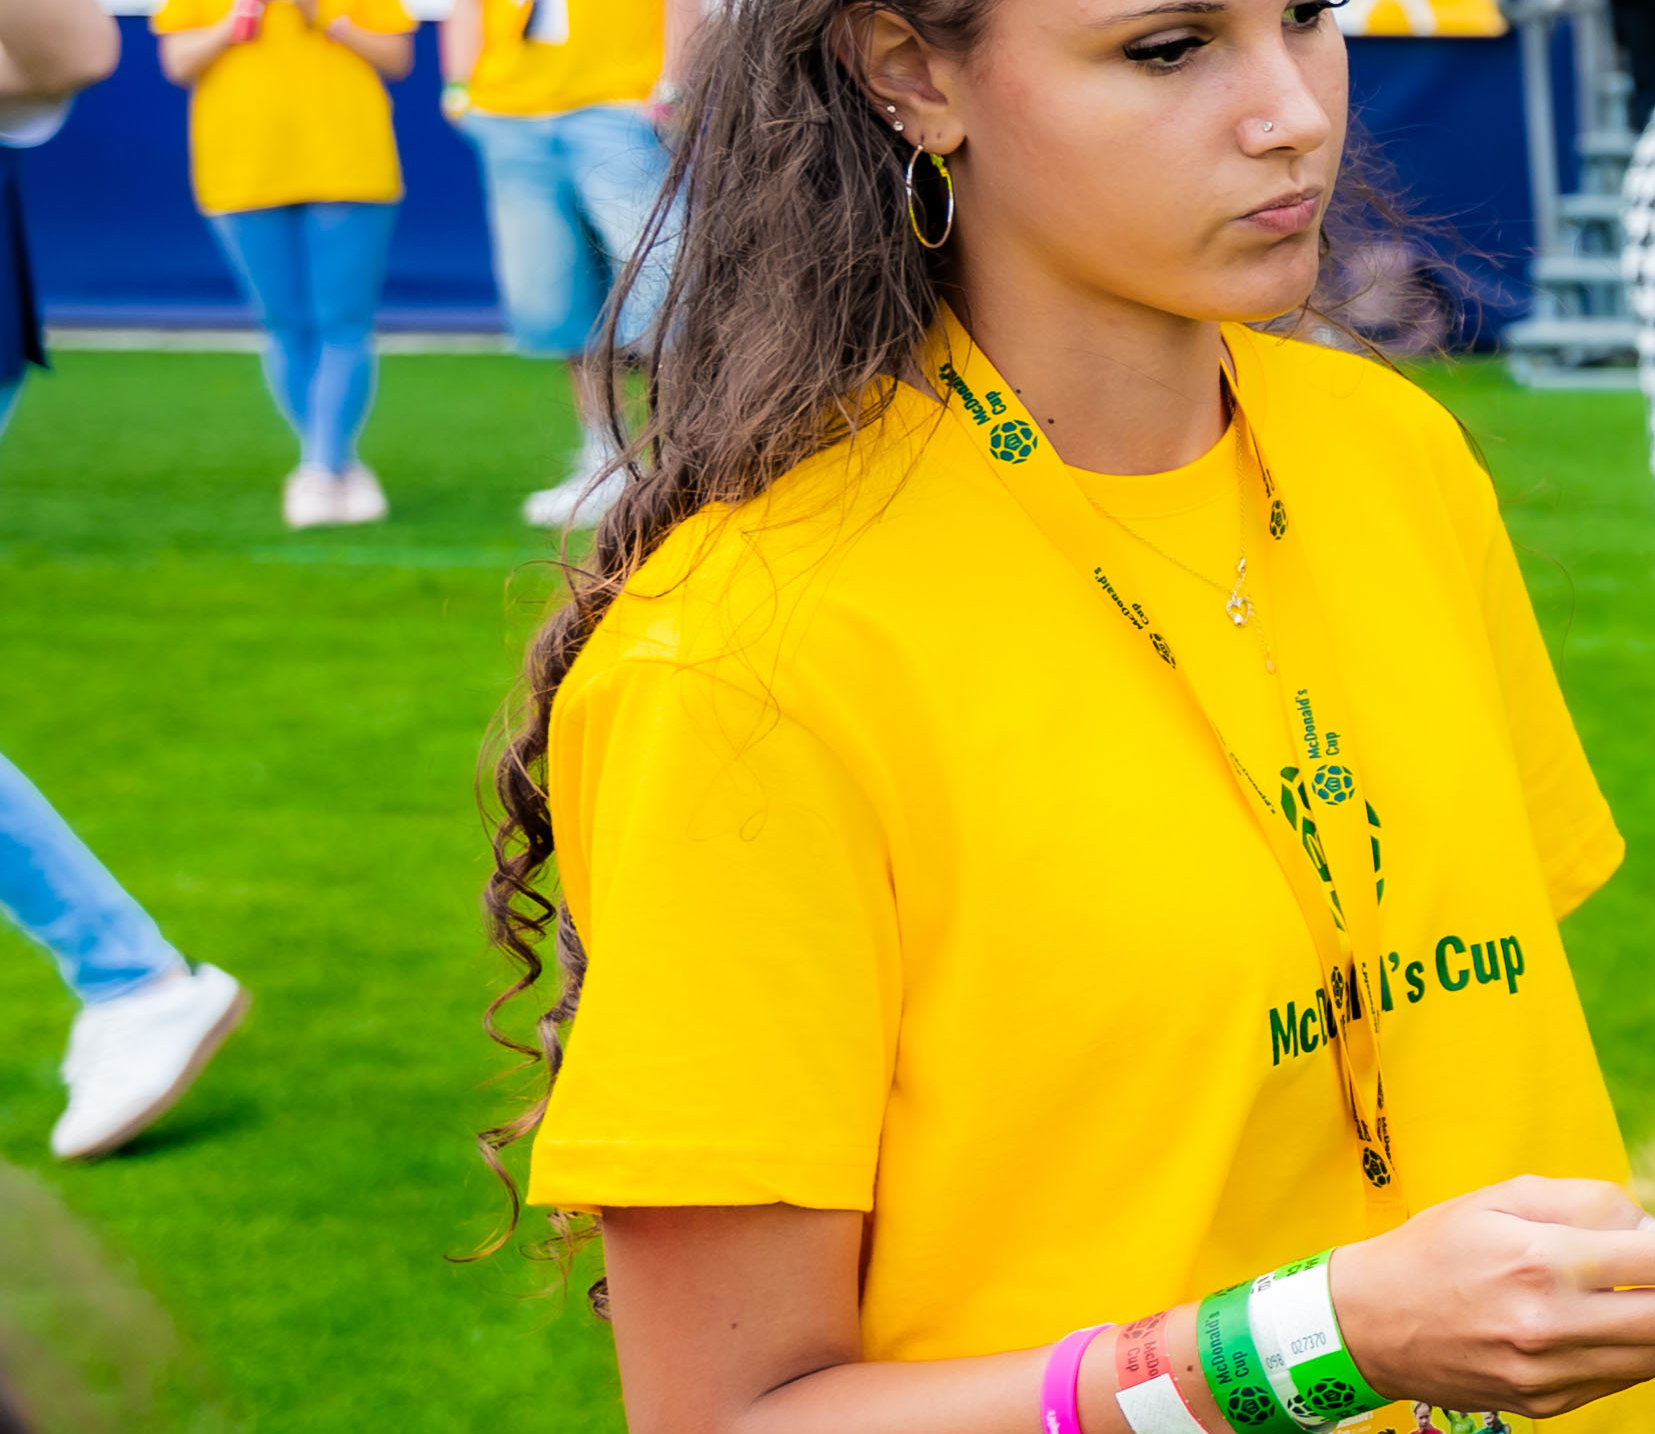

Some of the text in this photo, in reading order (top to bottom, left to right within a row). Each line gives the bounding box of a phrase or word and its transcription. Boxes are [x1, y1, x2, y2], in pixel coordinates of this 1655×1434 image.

[985, 391, 1006, 415] Cup
[1131, 603, 1149, 625] Cup
[1295, 689, 1321, 759] McDonald's
[1326, 732, 1341, 755] Cup
[1435, 935, 1525, 995] Cup
[1205, 1311, 1233, 1385] McDonald's
[1290, 1332, 1327, 1355] 027370
[1126, 1347, 1140, 1372] Cup
[1232, 1351, 1249, 1378] Cup
